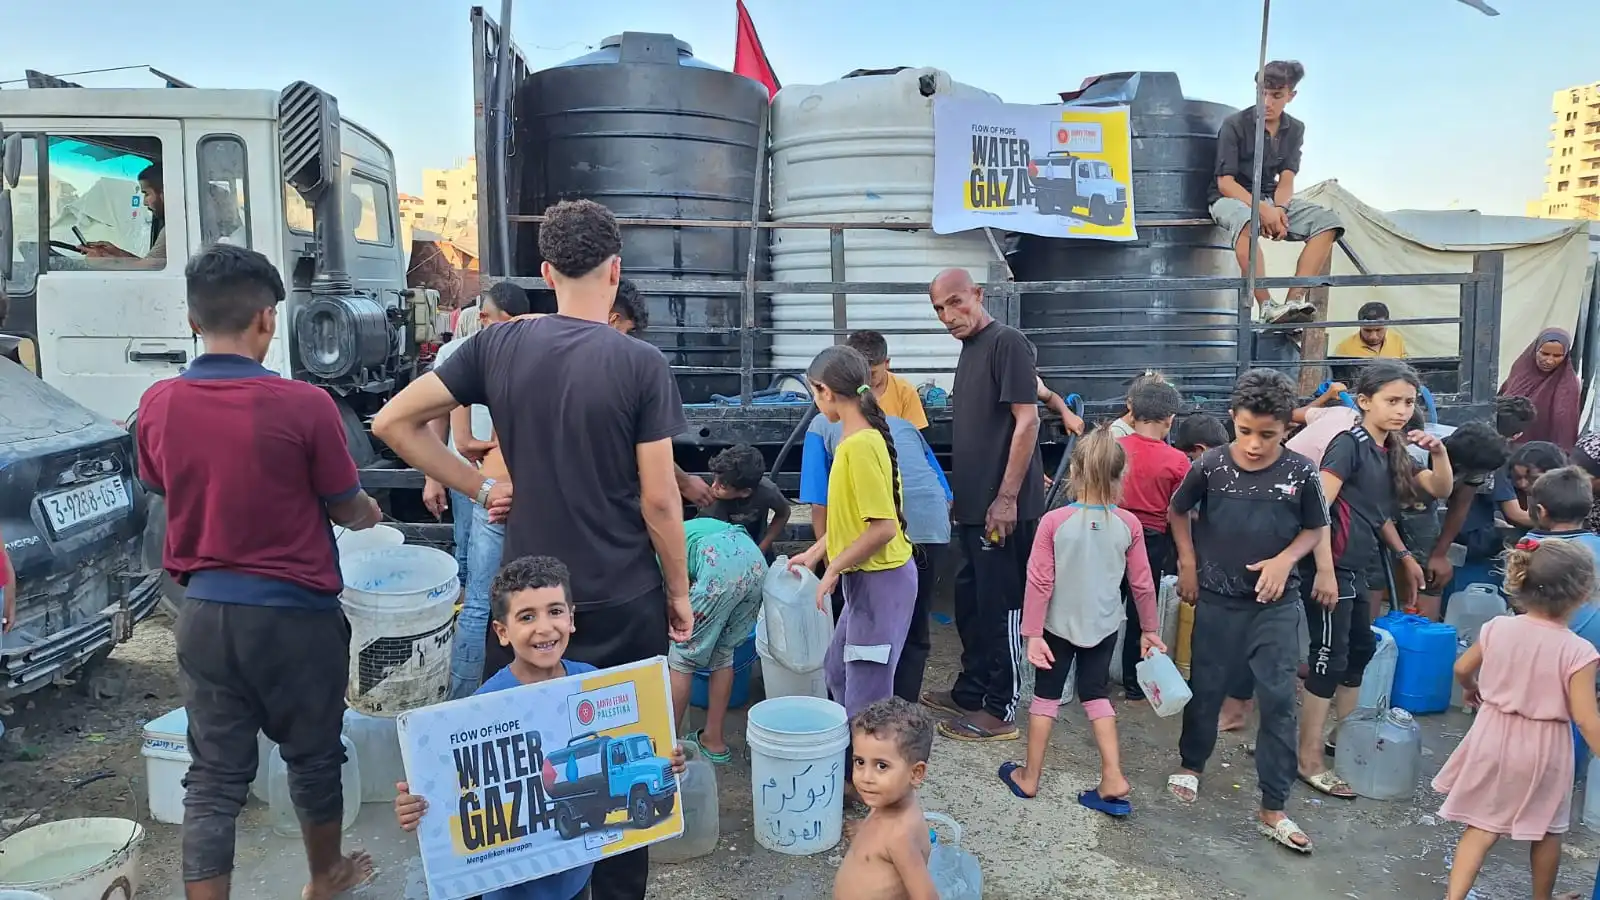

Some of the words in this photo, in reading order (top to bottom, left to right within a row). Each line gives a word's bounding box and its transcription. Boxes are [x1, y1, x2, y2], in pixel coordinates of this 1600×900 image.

[971, 124, 988, 133] FLOW
[990, 126, 998, 134] OF
[999, 127, 1017, 136] HOPE
[972, 134, 1030, 167] WATER
[970, 167, 1033, 208] GAZA
[597, 703, 631, 719] PALESTINA
[450, 728, 478, 745] FLOW
[480, 726, 493, 738] OF
[494, 719, 520, 734] HOPE
[453, 730, 543, 789] WATER
[762, 764, 813, 815] كرم
[788, 762, 839, 813] أبو
[459, 775, 551, 850] GAZA
[505, 842, 533, 857] Harapan
